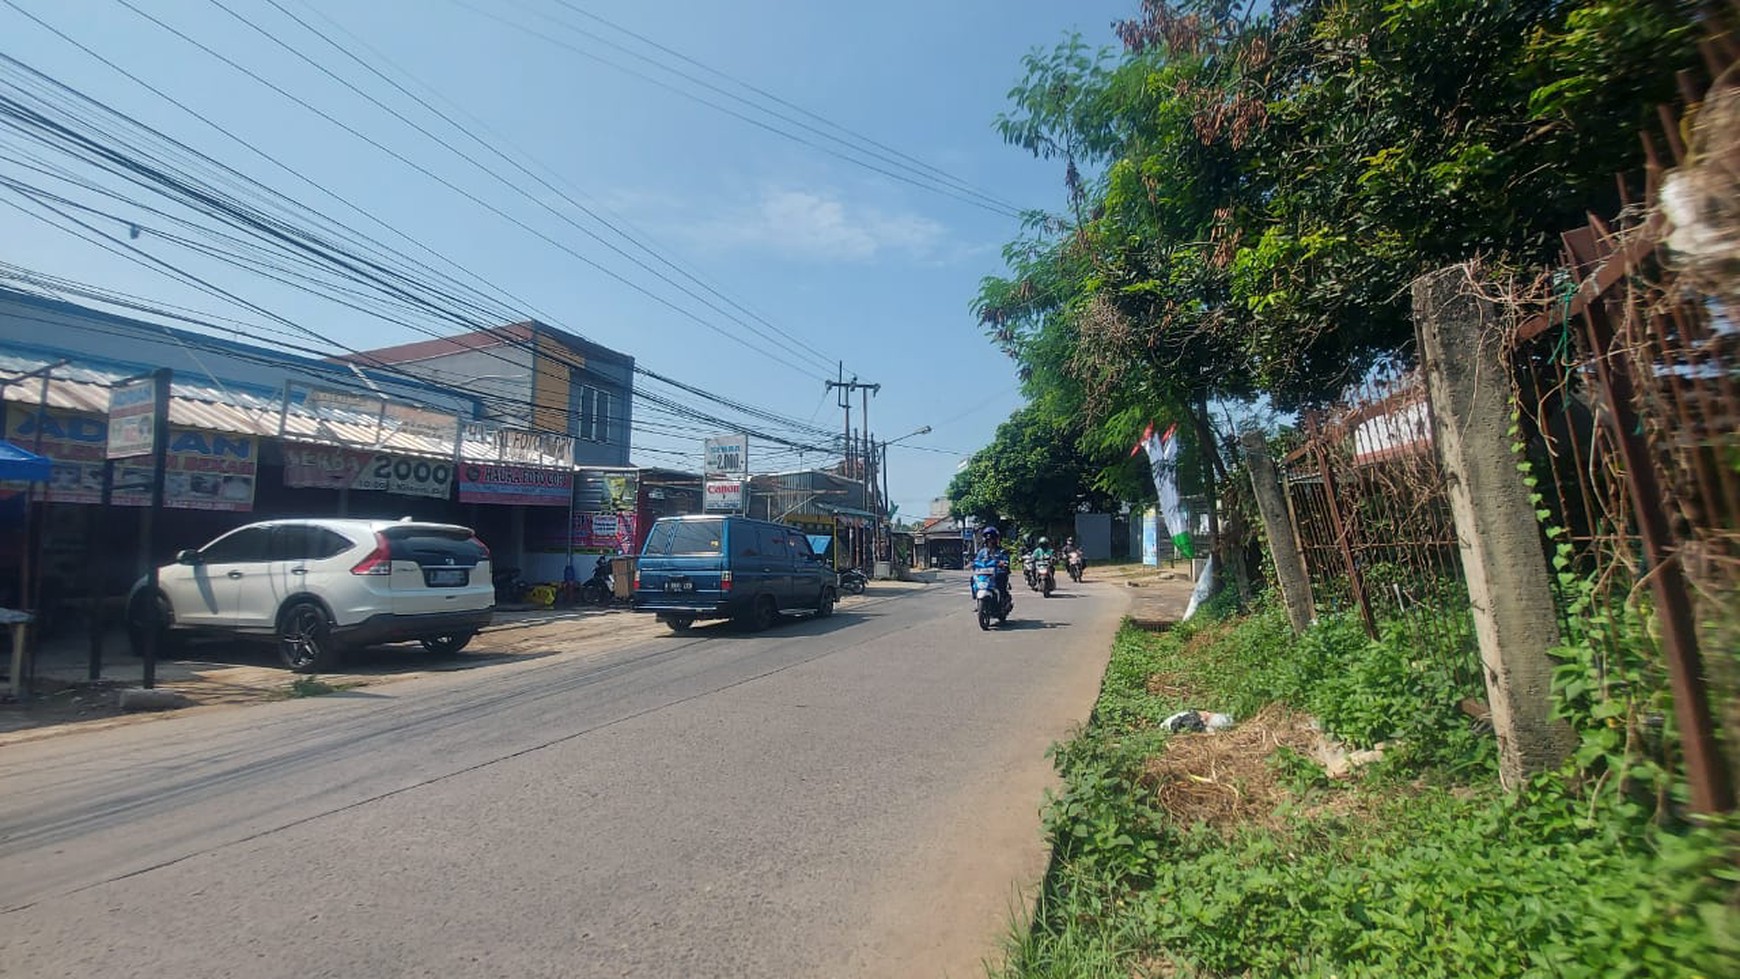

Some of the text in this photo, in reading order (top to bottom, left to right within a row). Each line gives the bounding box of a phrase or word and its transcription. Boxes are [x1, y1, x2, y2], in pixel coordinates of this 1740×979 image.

[375, 455, 447, 485] 2000
[485, 467, 520, 484] HAURA
[522, 470, 545, 485] FOTO
[708, 485, 740, 494] Canon
